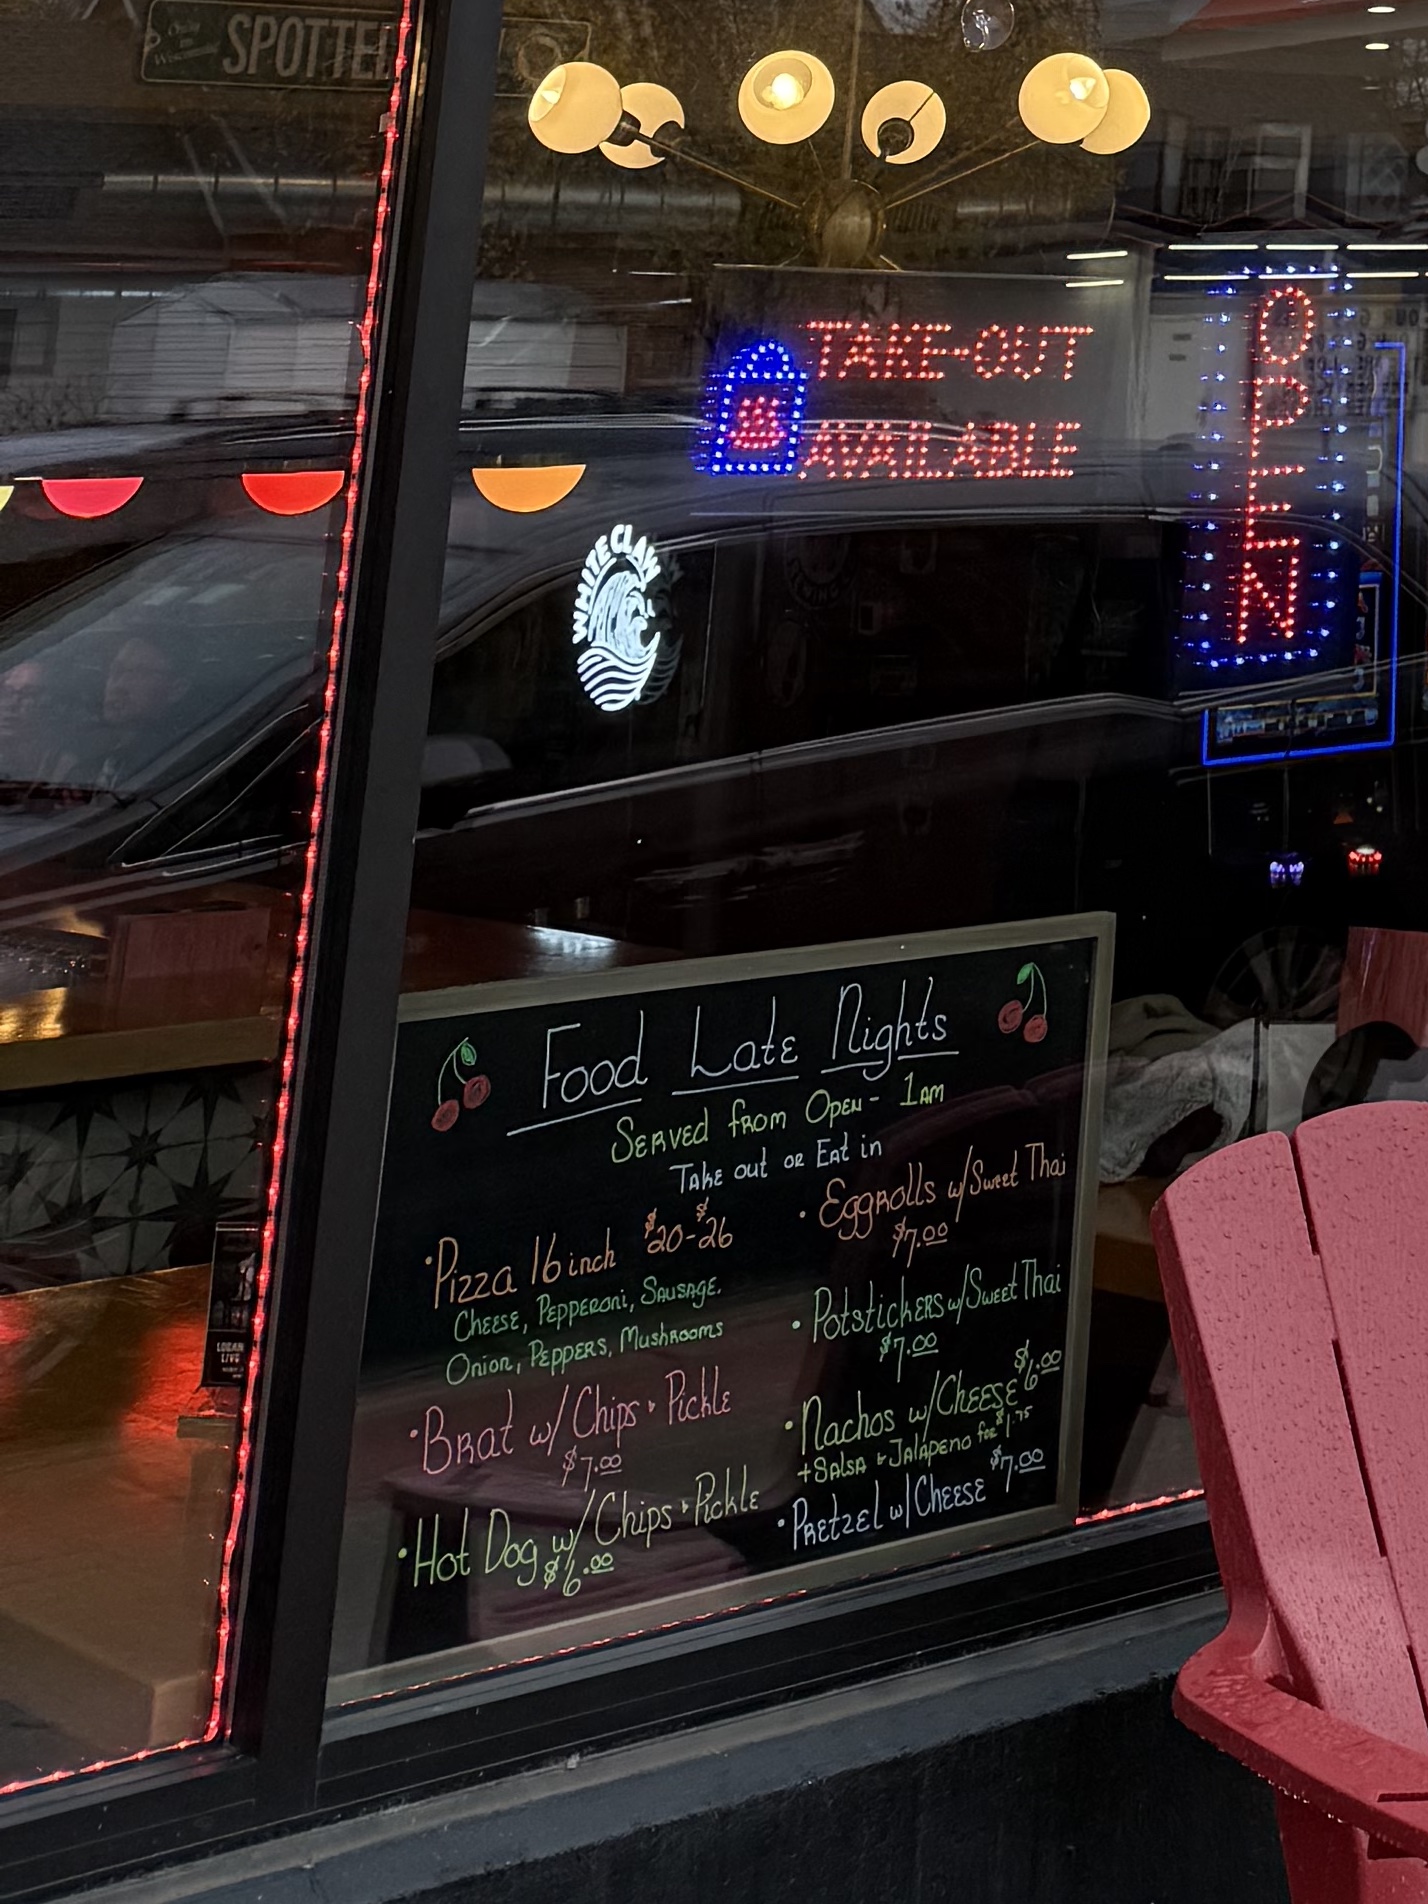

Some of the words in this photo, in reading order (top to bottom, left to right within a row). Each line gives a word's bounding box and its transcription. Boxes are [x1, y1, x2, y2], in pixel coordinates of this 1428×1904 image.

[807, 321, 1094, 380] TAKE-OUT
[799, 421, 1081, 479] AVAILABLE
[1237, 285, 1314, 645] OPEN
[542, 1010, 648, 1109] Food
[690, 996, 799, 1078] Late
[832, 977, 948, 1081] Nights
[734, 1148, 768, 1179] out
[861, 1137, 882, 1160] in
[1025, 1142, 1066, 1181] Thai
[434, 1236, 517, 1309] Pizza
[532, 1233, 561, 1285] 16
[568, 1228, 616, 1276] inch
[1022, 1258, 1061, 1300] Thai
[423, 1389, 514, 1474] Brat
[665, 1366, 731, 1425] Pickle
[802, 1390, 895, 1455] Nachos
[414, 1507, 470, 1586] Hot
[485, 1508, 538, 1586] Dog
[695, 1464, 760, 1526] Pickle
